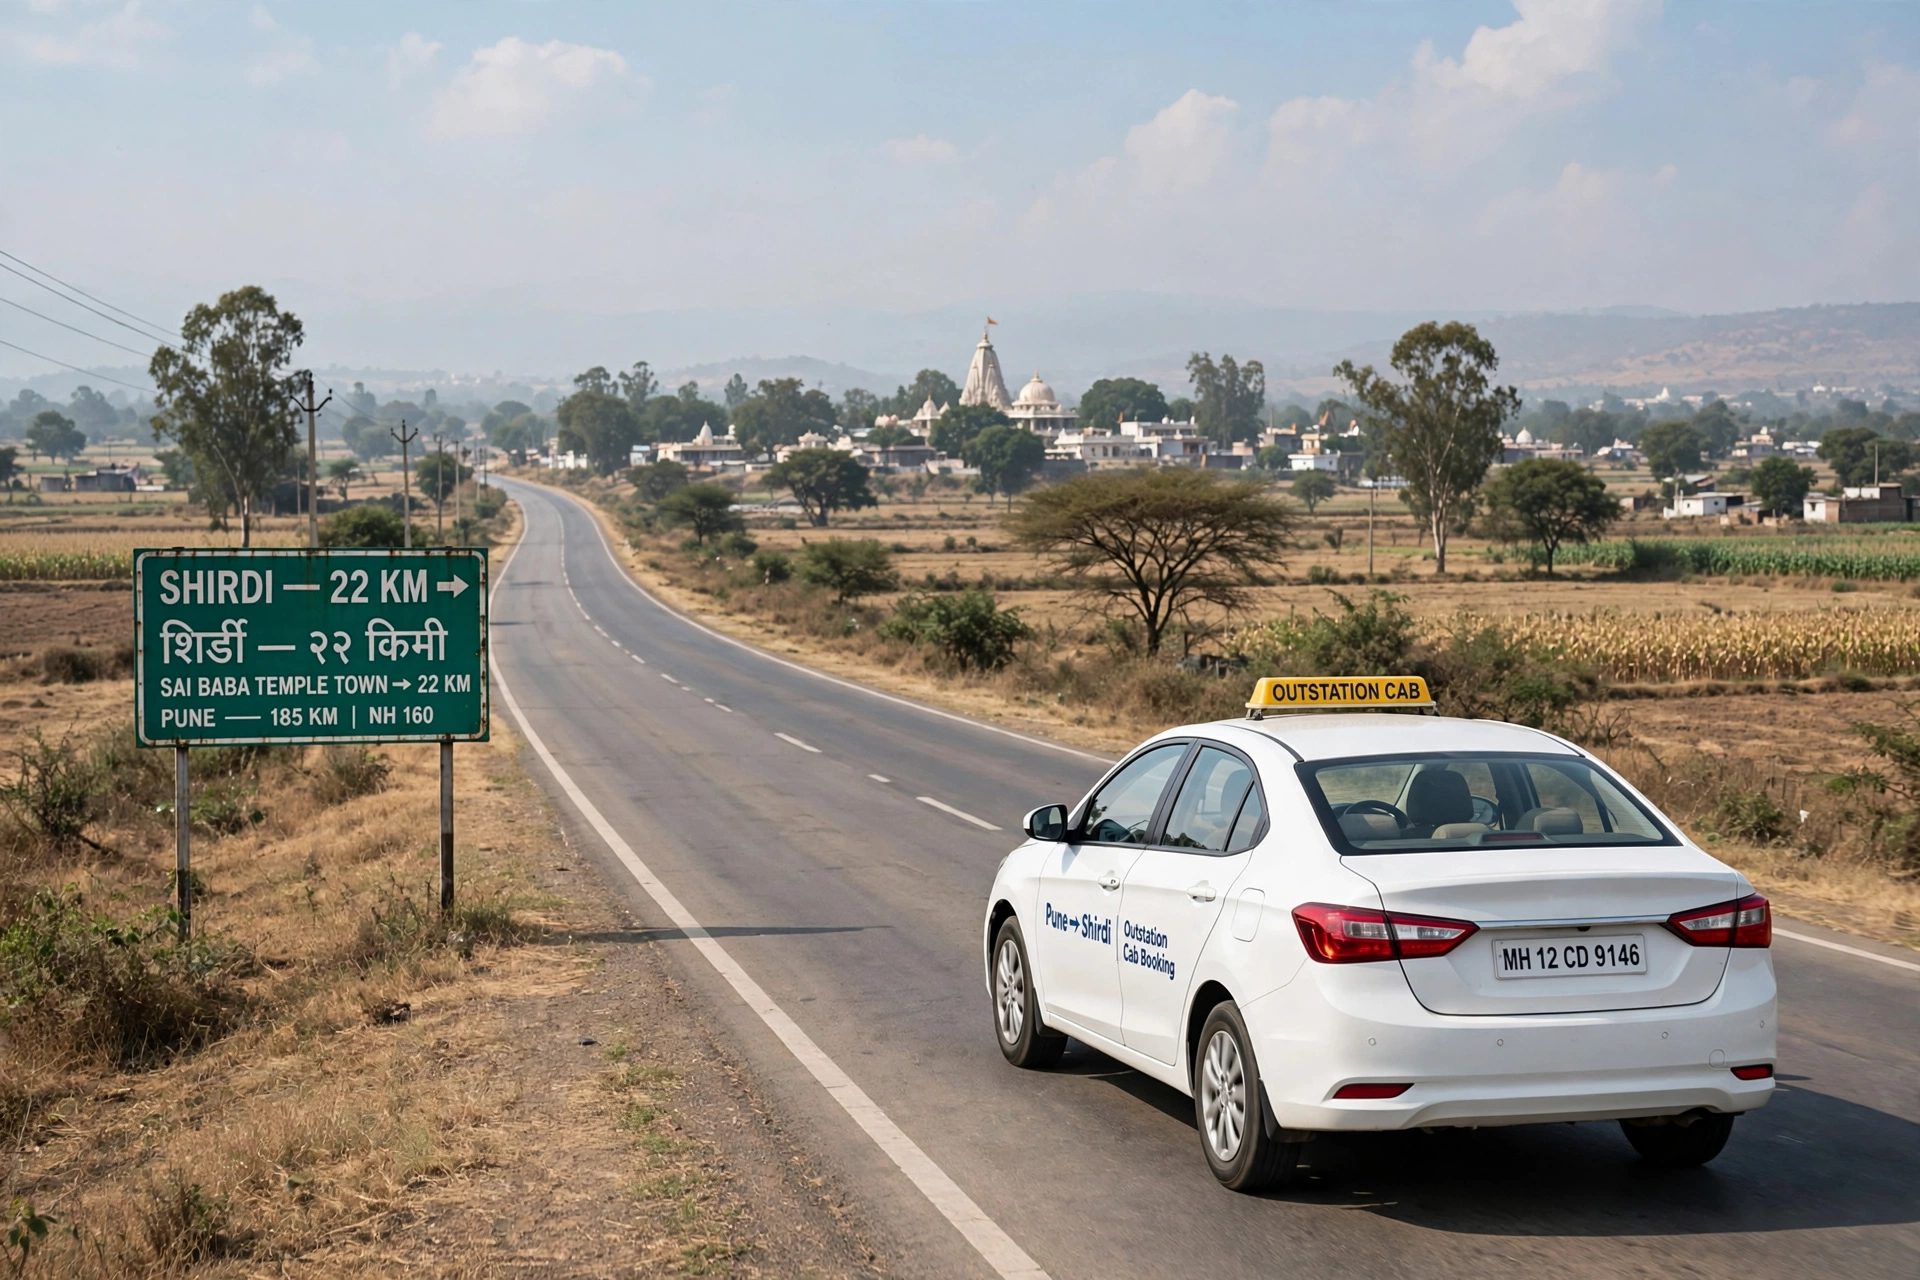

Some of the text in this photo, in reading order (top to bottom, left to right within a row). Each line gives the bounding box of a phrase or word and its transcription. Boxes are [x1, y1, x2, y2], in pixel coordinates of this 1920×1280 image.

[159, 568, 428, 605] SHIRDI 22 KM
[159, 617, 449, 665] शिर्डी २२ किमी
[160, 674, 471, 698] SAI BABA TEMPLE TOWN 22 KM
[1272, 682, 1421, 702] OUTSTATION CAB
[161, 705, 434, 728] PUNE 185 KM NH 160
[1045, 902, 1112, 945] Pune Shirdi
[1123, 919, 1168, 949] Outstation
[1123, 942, 1175, 981] Cab Booking
[1502, 943, 1640, 971] MH 12 CD 9146
